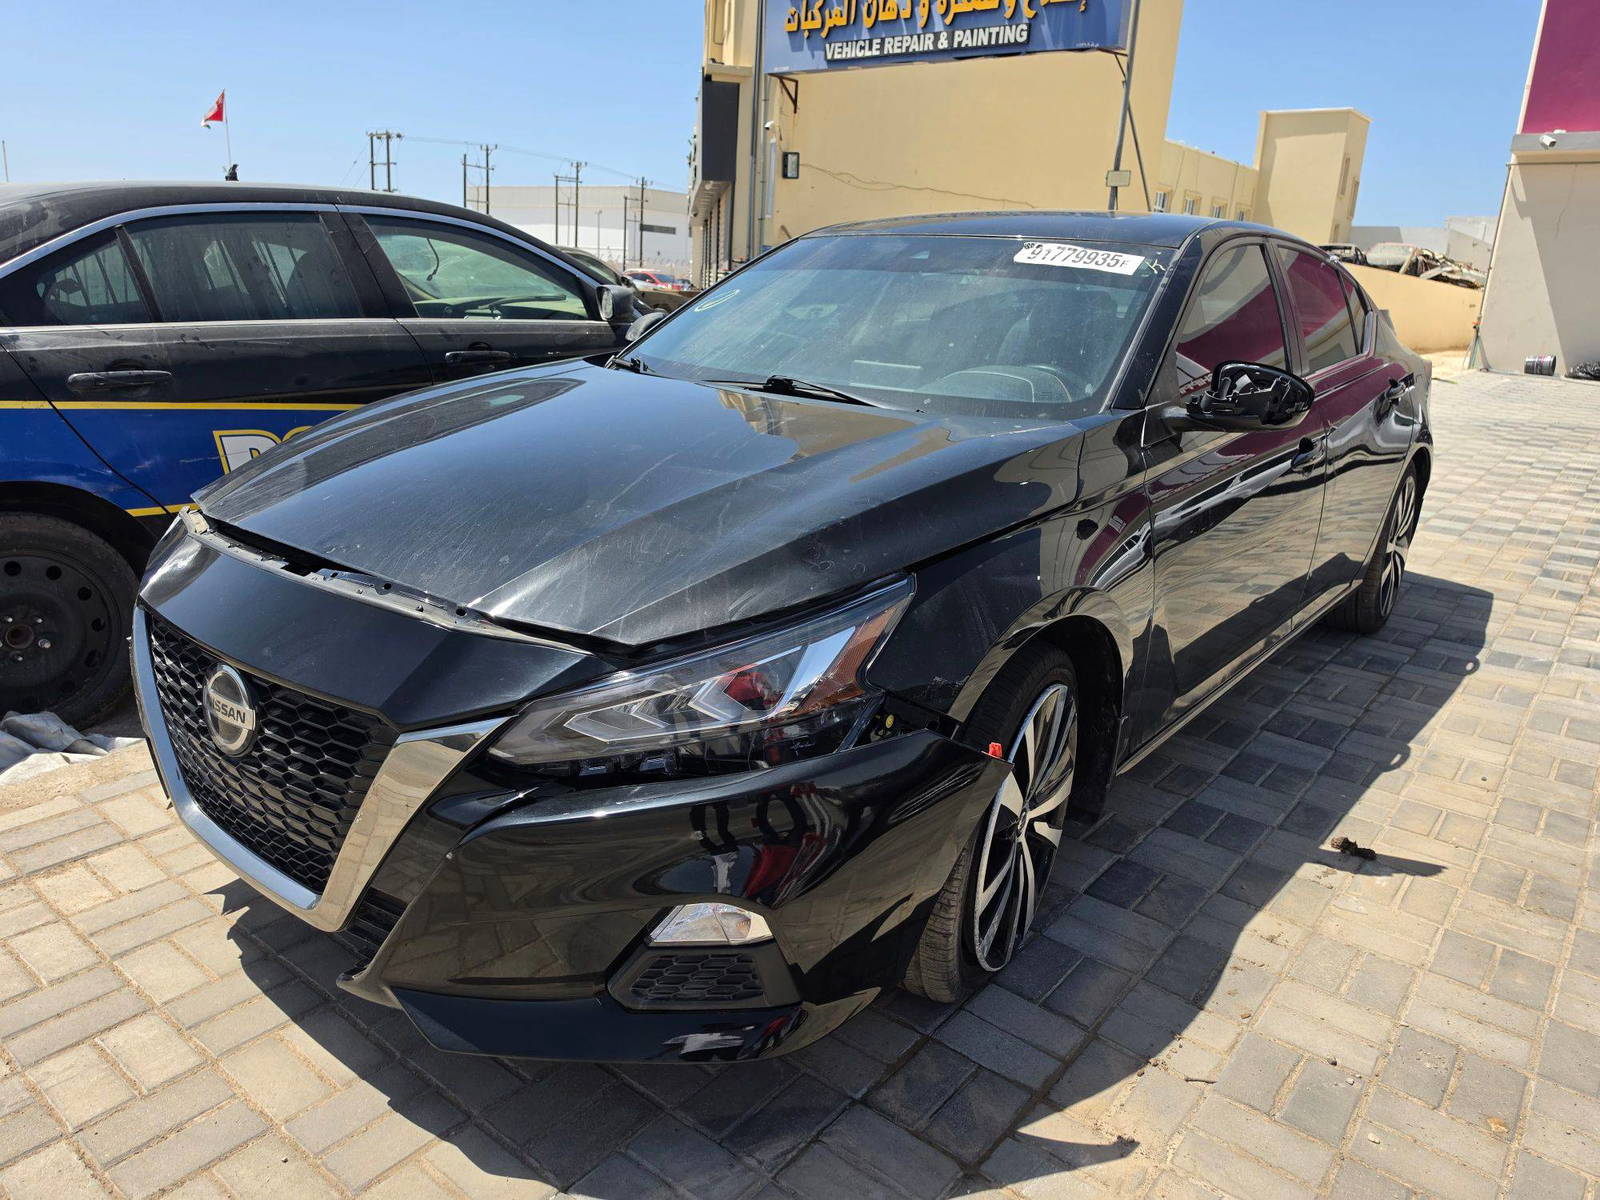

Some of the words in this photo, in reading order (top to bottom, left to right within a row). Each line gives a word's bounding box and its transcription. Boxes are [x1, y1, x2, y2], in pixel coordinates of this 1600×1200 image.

[784, 0, 857, 38] المركبات
[825, 39, 881, 60] VEHICLE
[884, 33, 935, 54] REPAIR
[938, 31, 949, 49] &
[954, 24, 1028, 48] PAINTING
[209, 696, 246, 724] ISSAN
